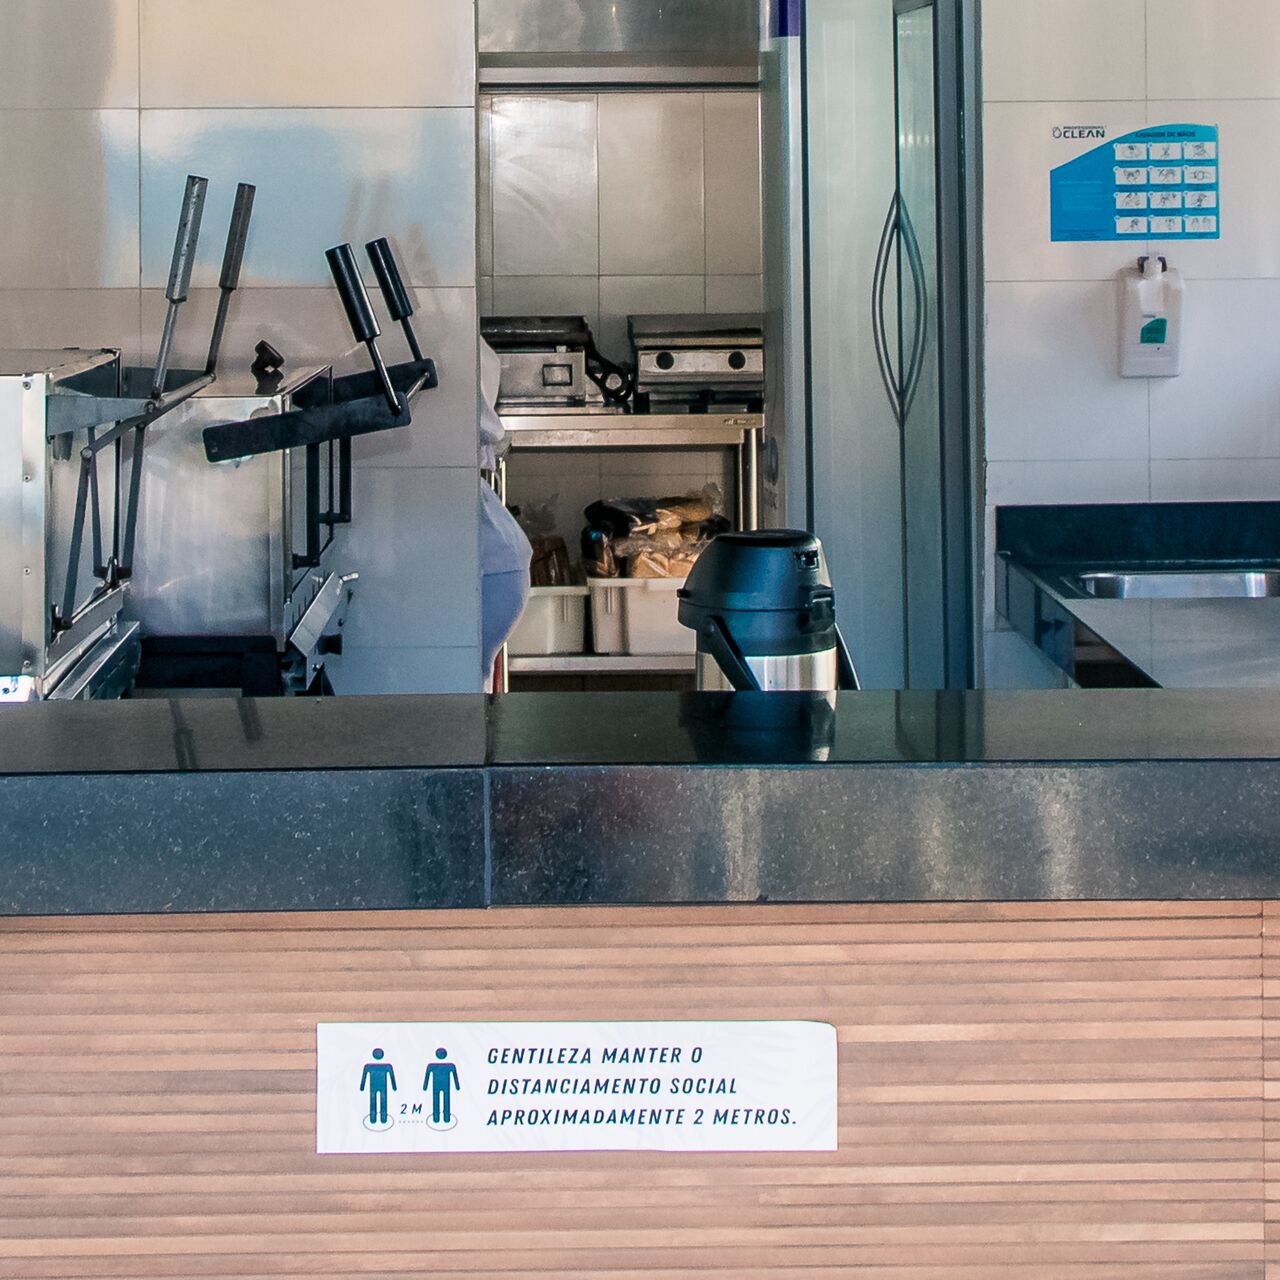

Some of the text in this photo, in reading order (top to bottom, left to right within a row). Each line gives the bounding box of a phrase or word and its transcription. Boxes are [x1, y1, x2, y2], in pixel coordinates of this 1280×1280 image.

[487, 1047, 703, 1065] GENTILEZA MANTER O
[487, 1077, 738, 1095] DISTANCIAMENTO SOCIAL
[400, 1103, 423, 1115] 2 M
[486, 1108, 798, 1126] APROXIMADAMENTE 2 METROS.
